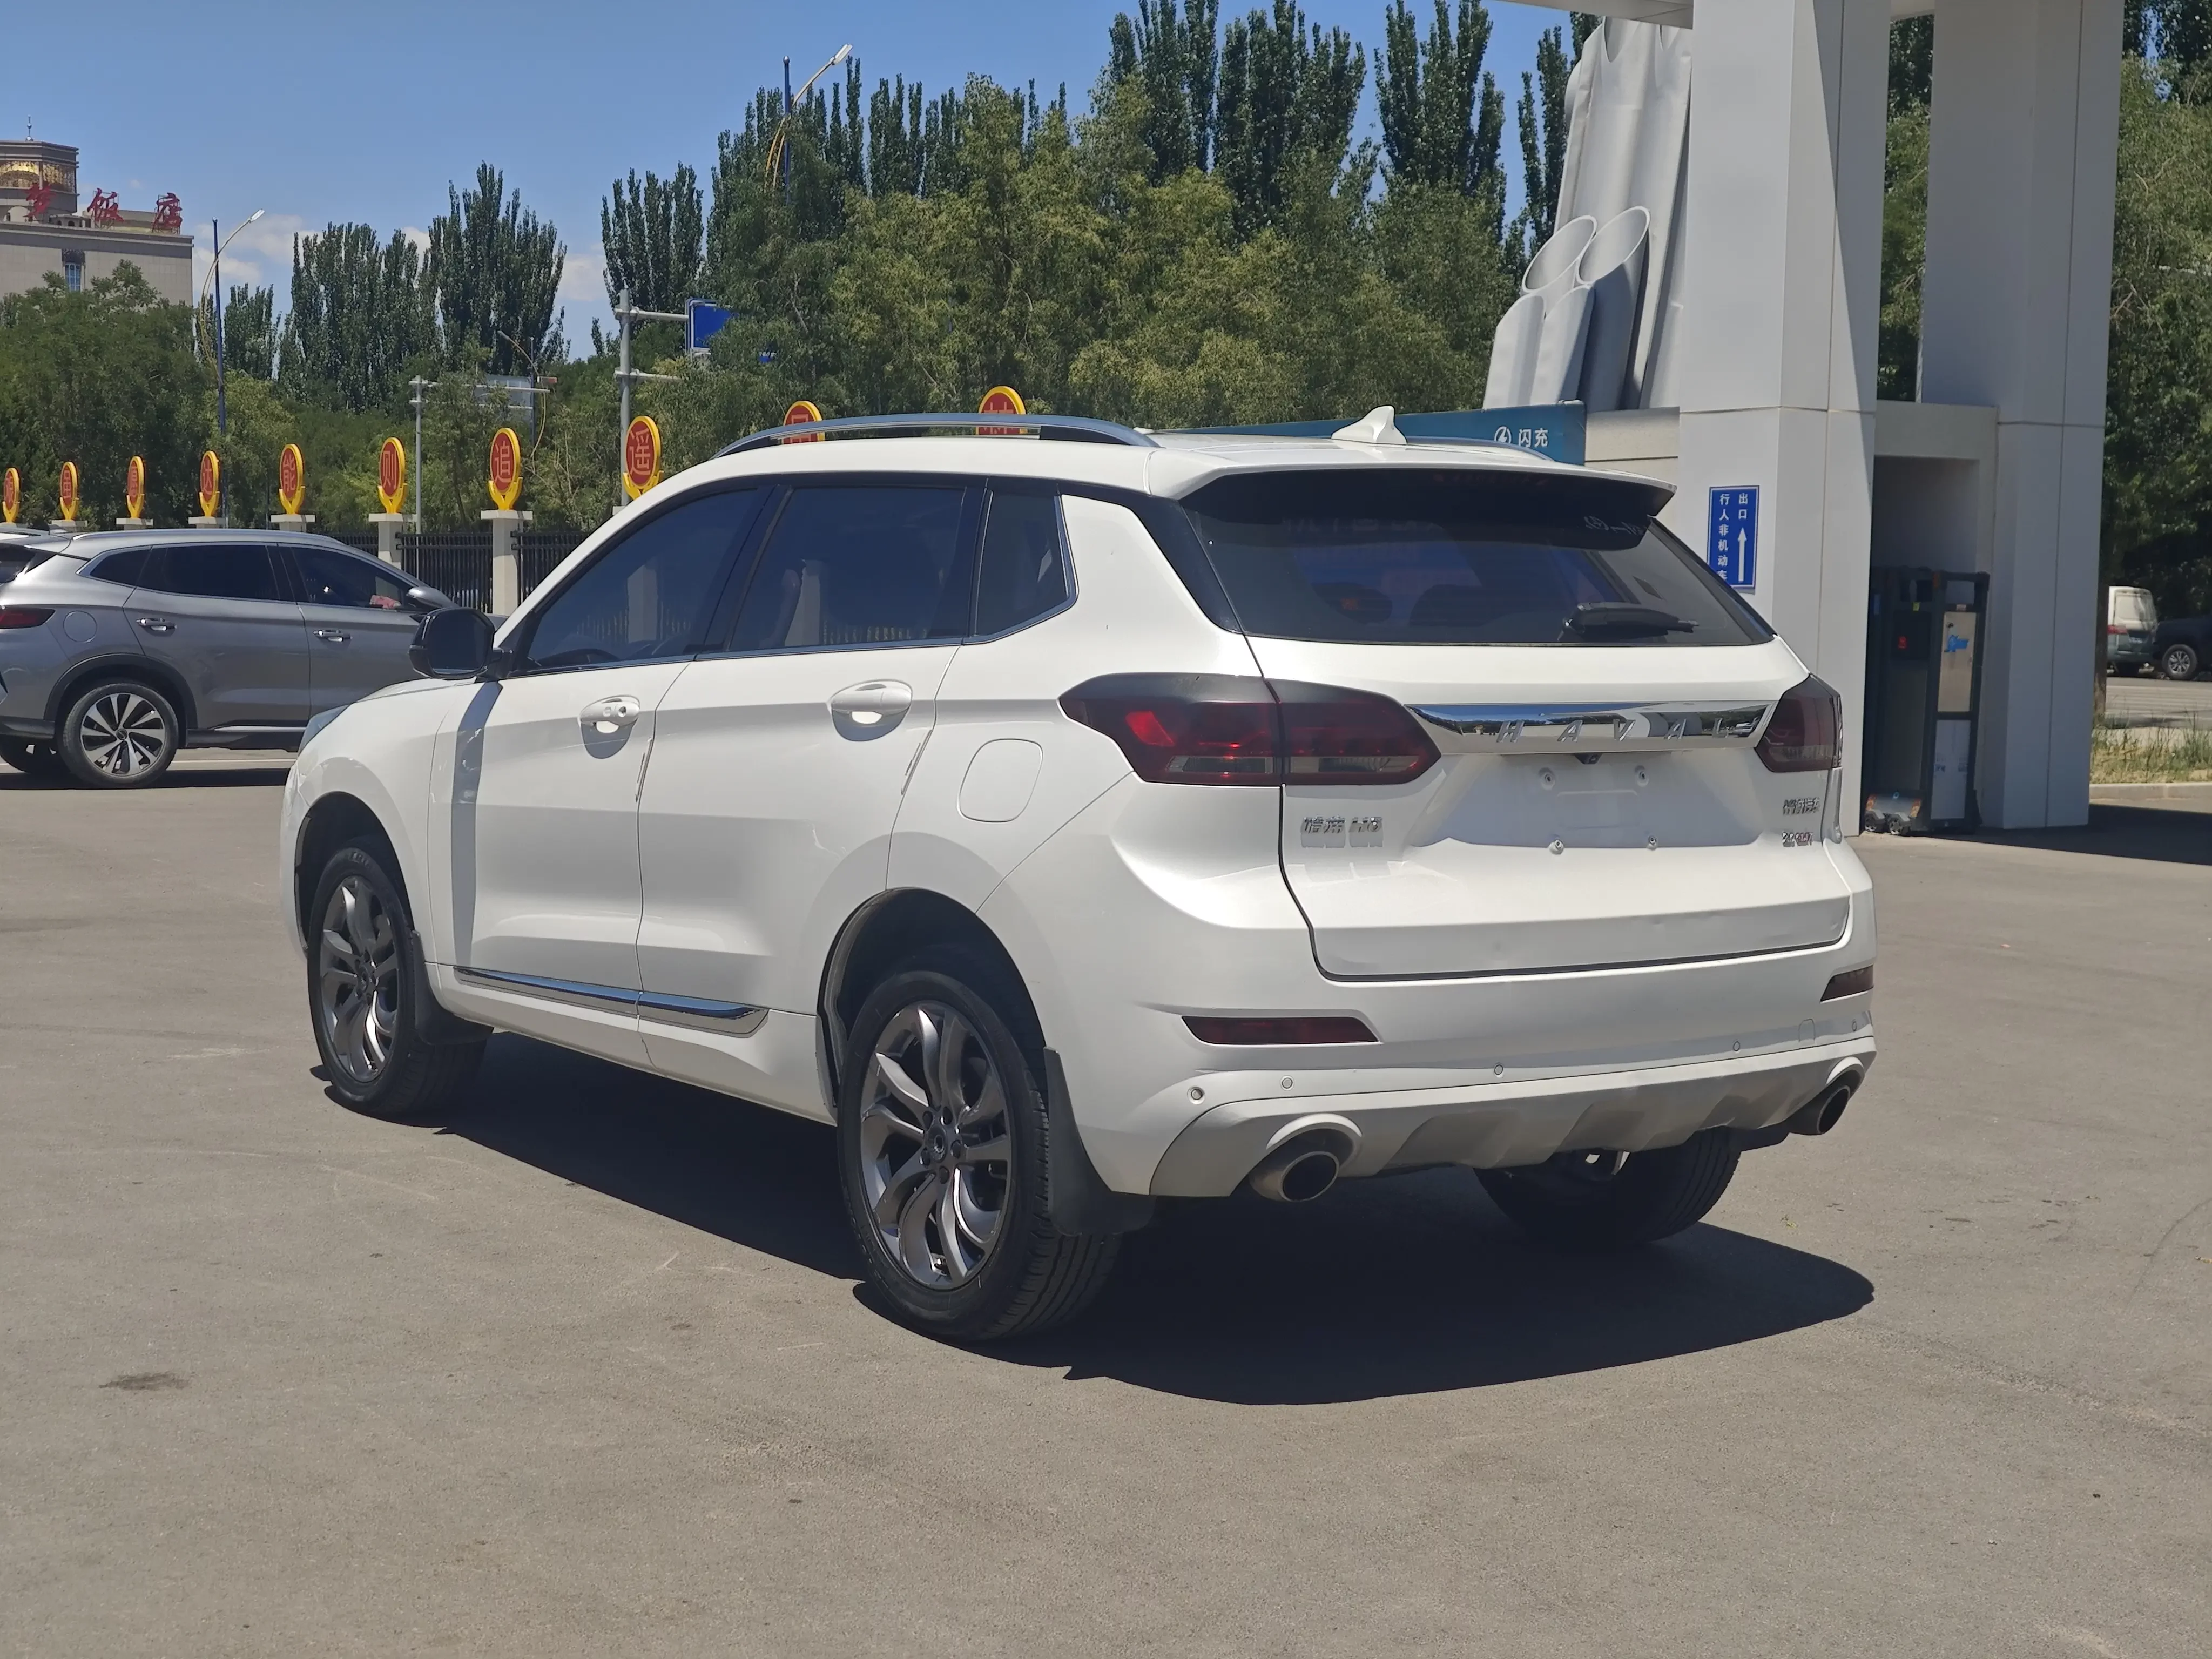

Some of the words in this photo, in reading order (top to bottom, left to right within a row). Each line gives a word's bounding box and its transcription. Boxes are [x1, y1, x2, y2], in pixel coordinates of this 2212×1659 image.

[629, 427, 651, 475] 遥
[1518, 427, 1549, 448] 闪充
[203, 460, 212, 495] 达
[283, 454, 295, 493] 能
[383, 449, 397, 489] 则
[494, 440, 512, 482] 追
[1738, 492, 1749, 520] 出口
[1496, 717, 1729, 743] HAVAL
